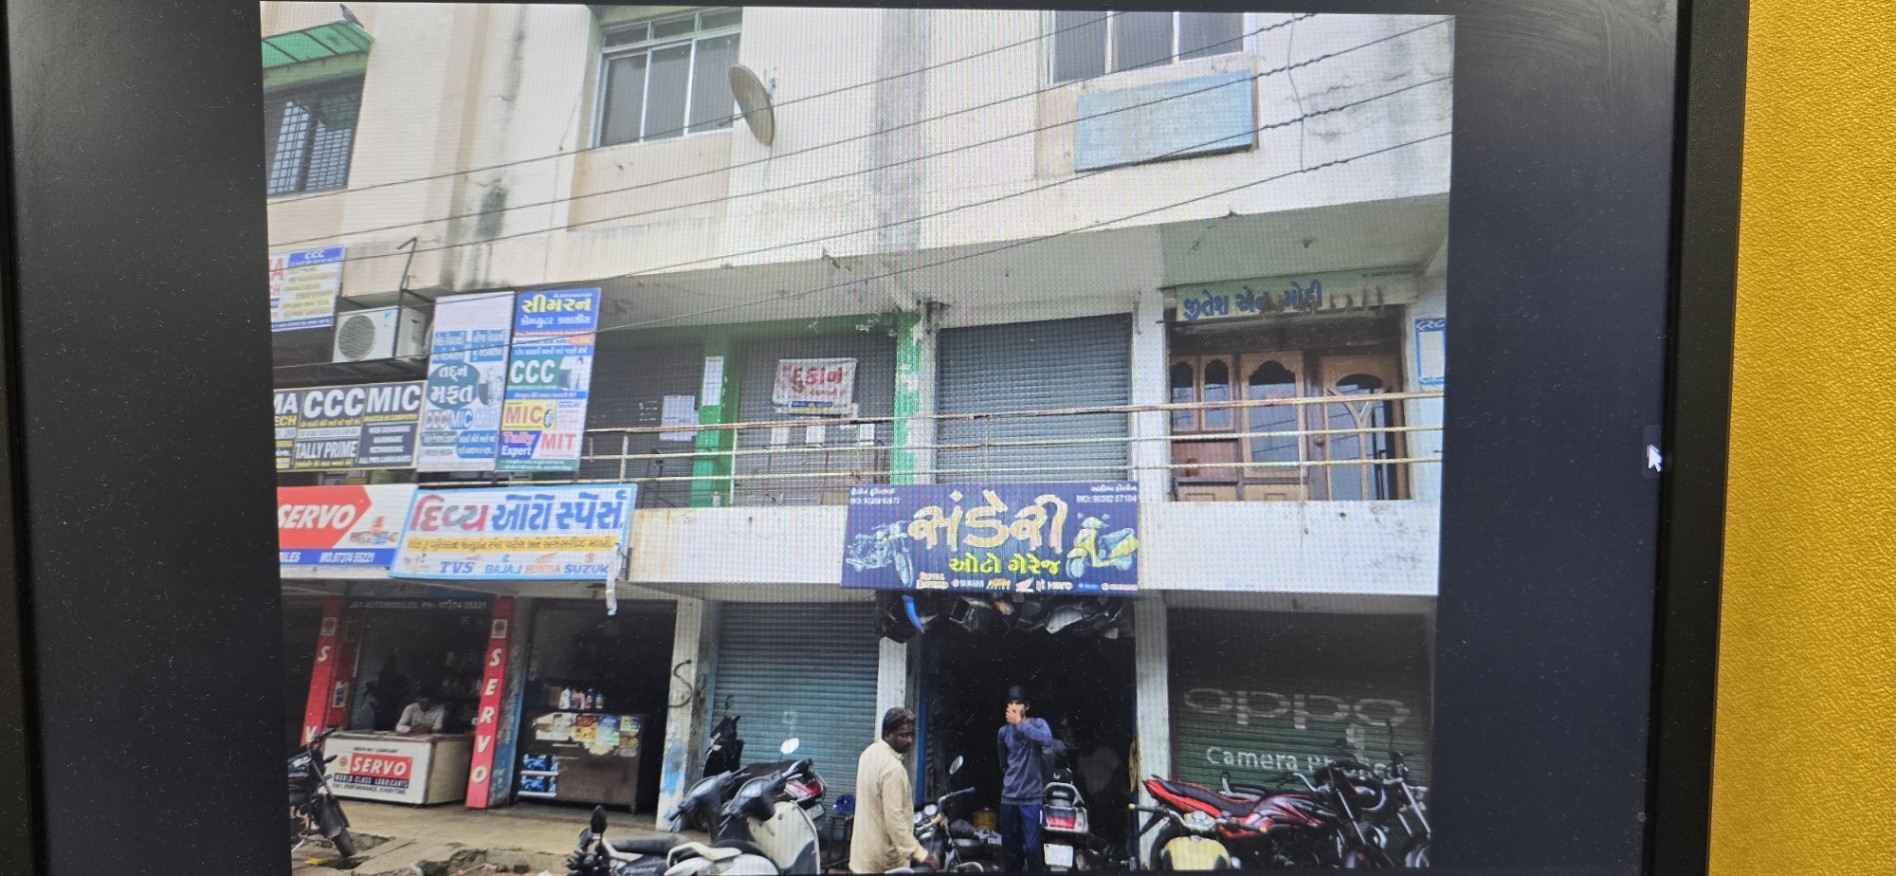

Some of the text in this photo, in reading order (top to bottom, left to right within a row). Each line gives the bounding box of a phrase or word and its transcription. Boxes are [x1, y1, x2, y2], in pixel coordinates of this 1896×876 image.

[522, 294, 592, 314] સીમરન
[510, 359, 555, 384] CCC
[304, 388, 366, 419] CCC
[366, 385, 421, 413] MIC
[430, 384, 474, 405] મફત
[505, 405, 543, 424] MIC
[503, 431, 535, 447] Tally
[541, 433, 577, 451] MIT
[295, 440, 359, 460] TALLY PRIME
[501, 445, 532, 458] Expert
[278, 504, 357, 530] SERVO
[409, 493, 491, 532] દિવ્ય
[440, 561, 475, 574] TVS
[484, 564, 521, 574] BAJAJ
[949, 551, 1061, 575] ઓટો ગેરેજ
[352, 756, 407, 777] SERVO
[1206, 746, 1298, 773] Camera
